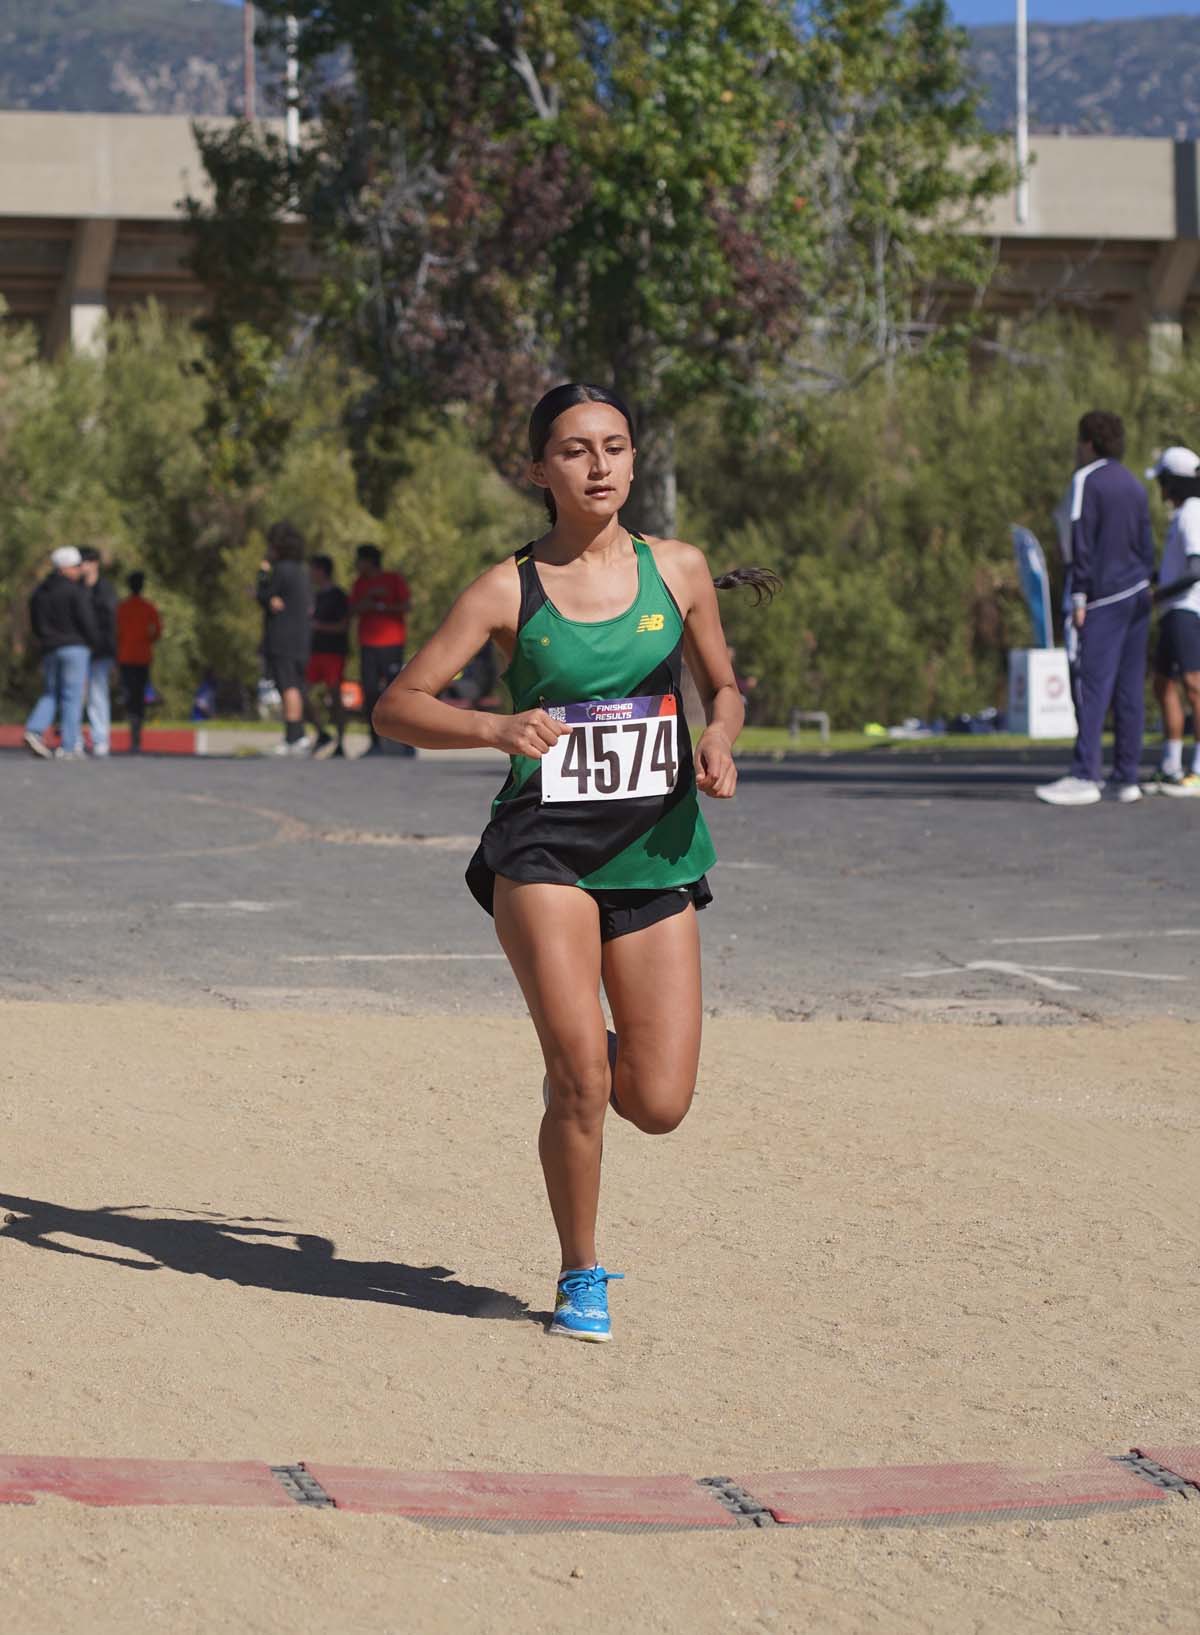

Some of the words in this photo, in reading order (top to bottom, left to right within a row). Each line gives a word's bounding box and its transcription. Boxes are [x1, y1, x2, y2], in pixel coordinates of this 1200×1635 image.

[596, 703, 633, 712] FINISHED
[595, 711, 632, 720] RESULTS
[561, 720, 676, 795] 4574
